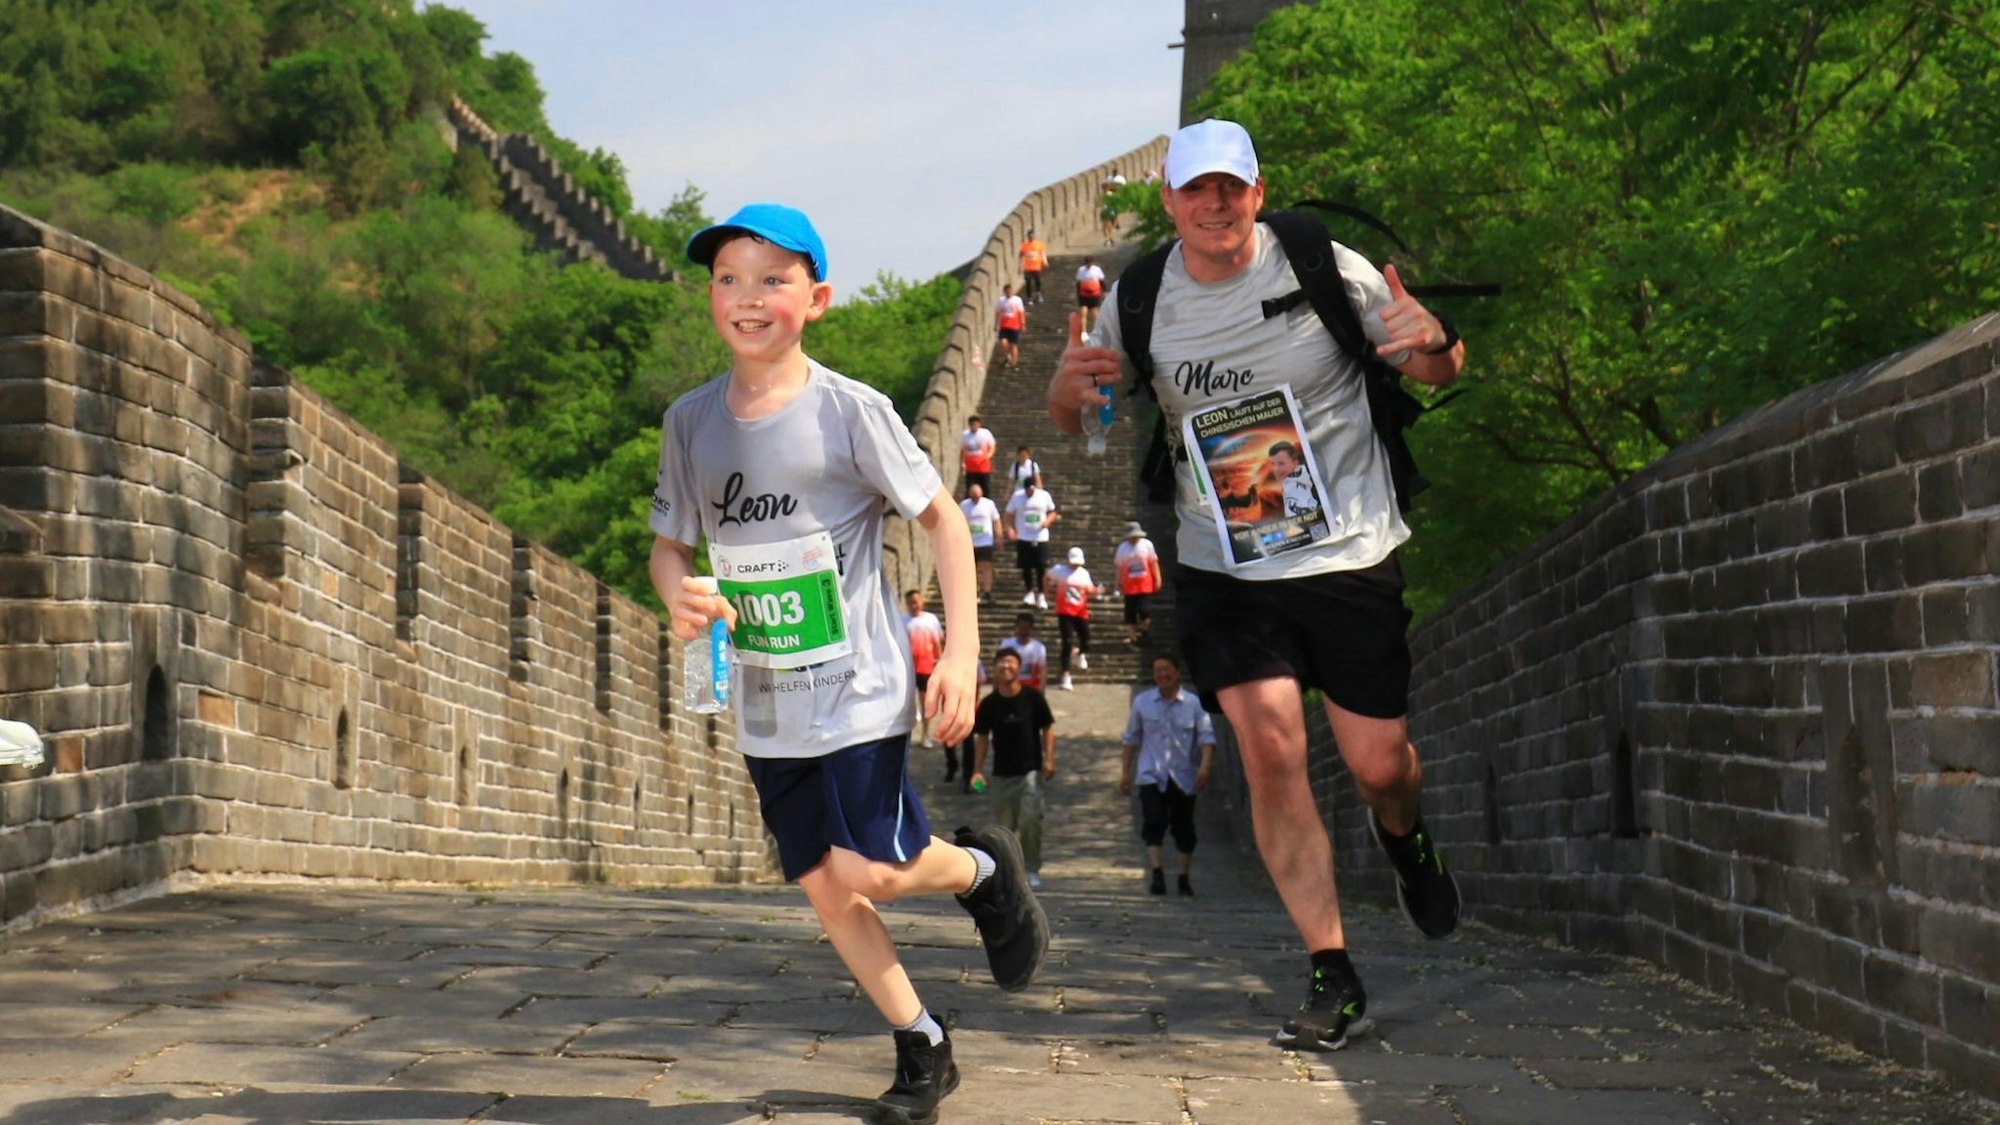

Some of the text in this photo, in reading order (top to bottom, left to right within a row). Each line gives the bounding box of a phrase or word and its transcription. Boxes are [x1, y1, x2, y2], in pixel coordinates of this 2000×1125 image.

[1175, 360, 1254, 396] Marc
[1195, 408, 1229, 429] LEON
[712, 471, 798, 527] Leon
[737, 562, 776, 574] CRAFT
[732, 590, 805, 627] 1003
[747, 634, 801, 649] FUN RUN
